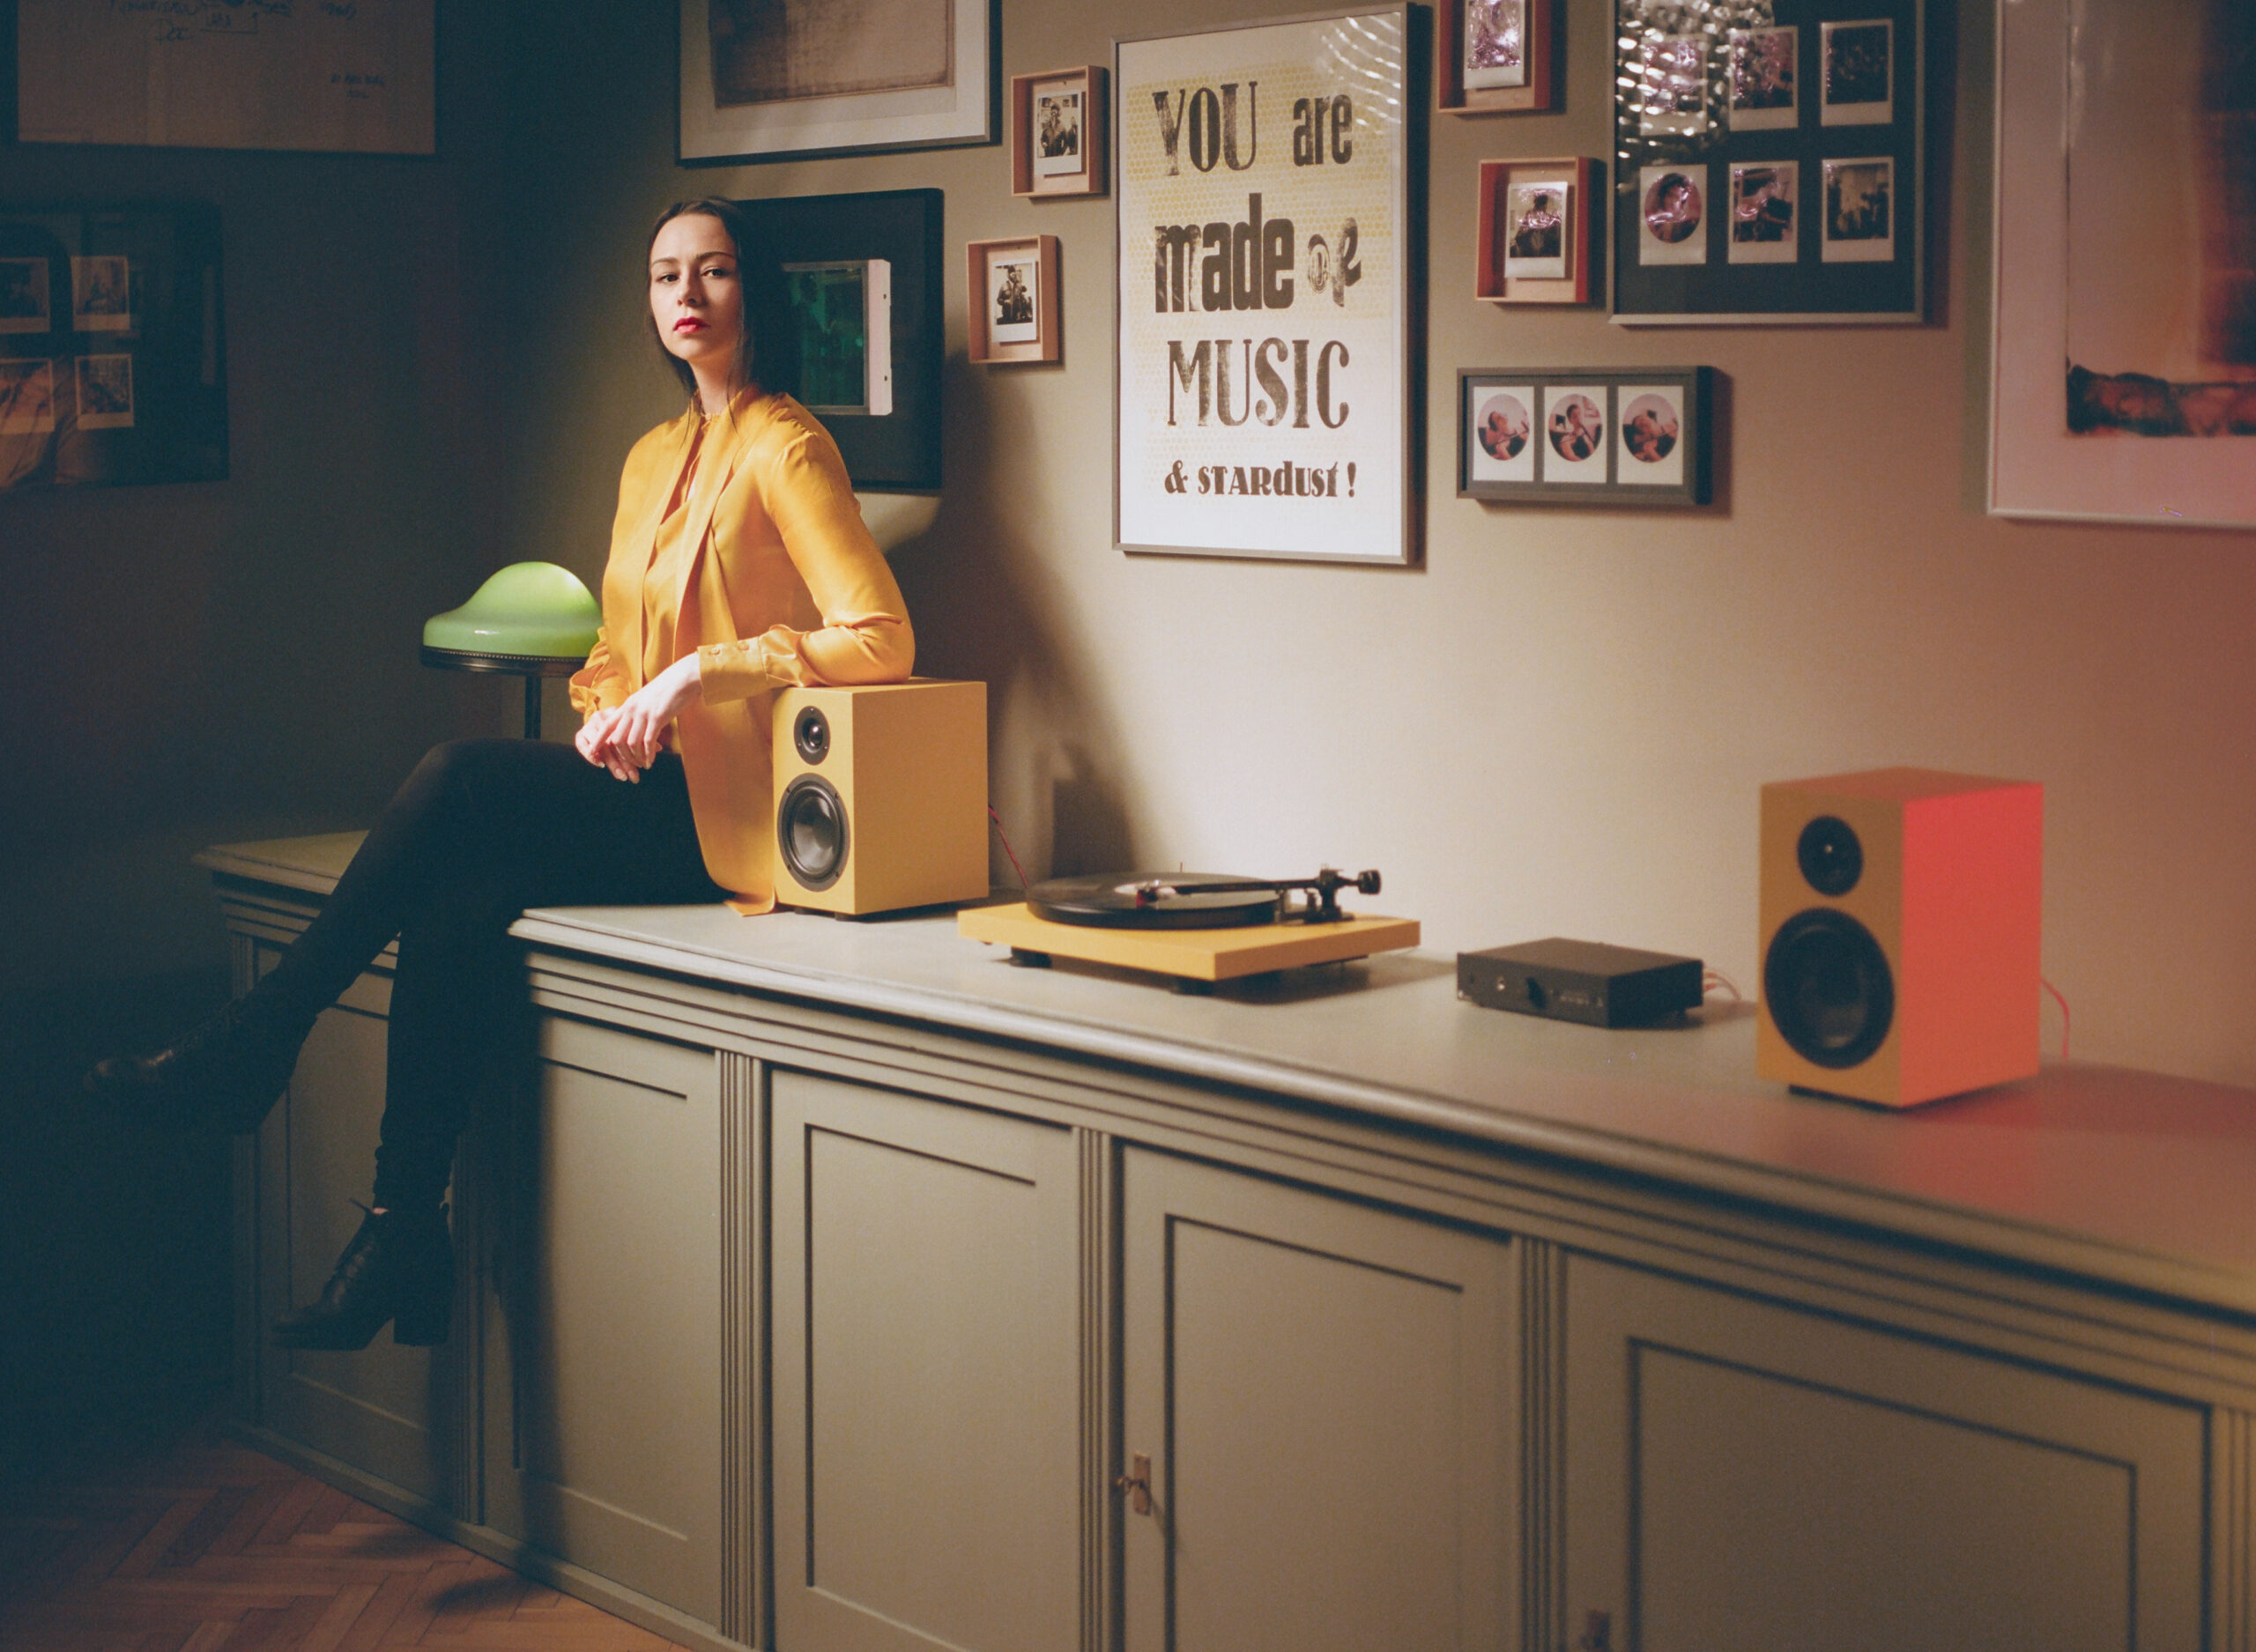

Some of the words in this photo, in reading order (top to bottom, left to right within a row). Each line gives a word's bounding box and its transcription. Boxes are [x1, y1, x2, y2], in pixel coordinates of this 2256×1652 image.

[1152, 81, 1258, 175] YOU
[1293, 93, 1352, 167] are
[1155, 193, 1294, 313] made
[1168, 337, 1349, 428] MUSIC
[1164, 460, 1188, 493] &
